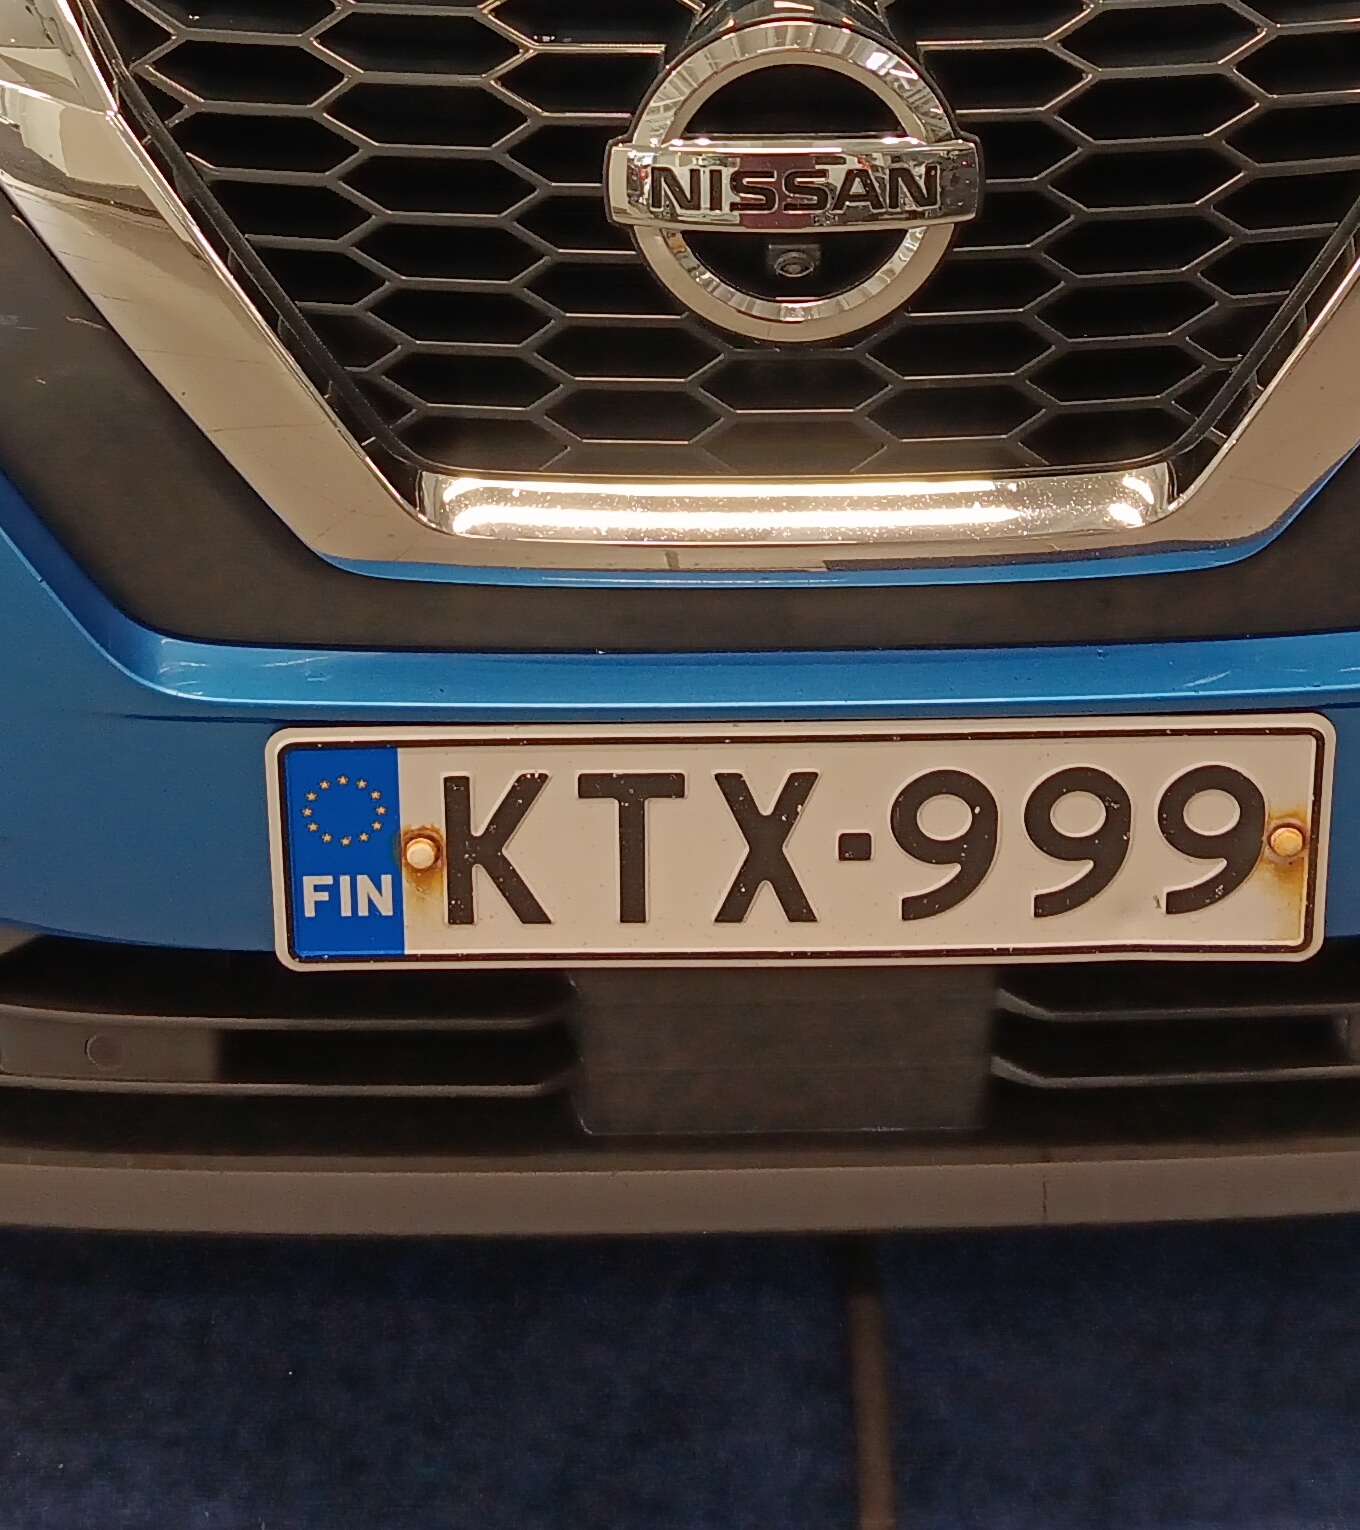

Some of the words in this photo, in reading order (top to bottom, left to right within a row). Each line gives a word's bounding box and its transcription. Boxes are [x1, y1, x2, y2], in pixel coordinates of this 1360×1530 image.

[649, 164, 940, 215] NISSAN
[442, 764, 1267, 926] KTX-999
[302, 874, 394, 918] FIN
